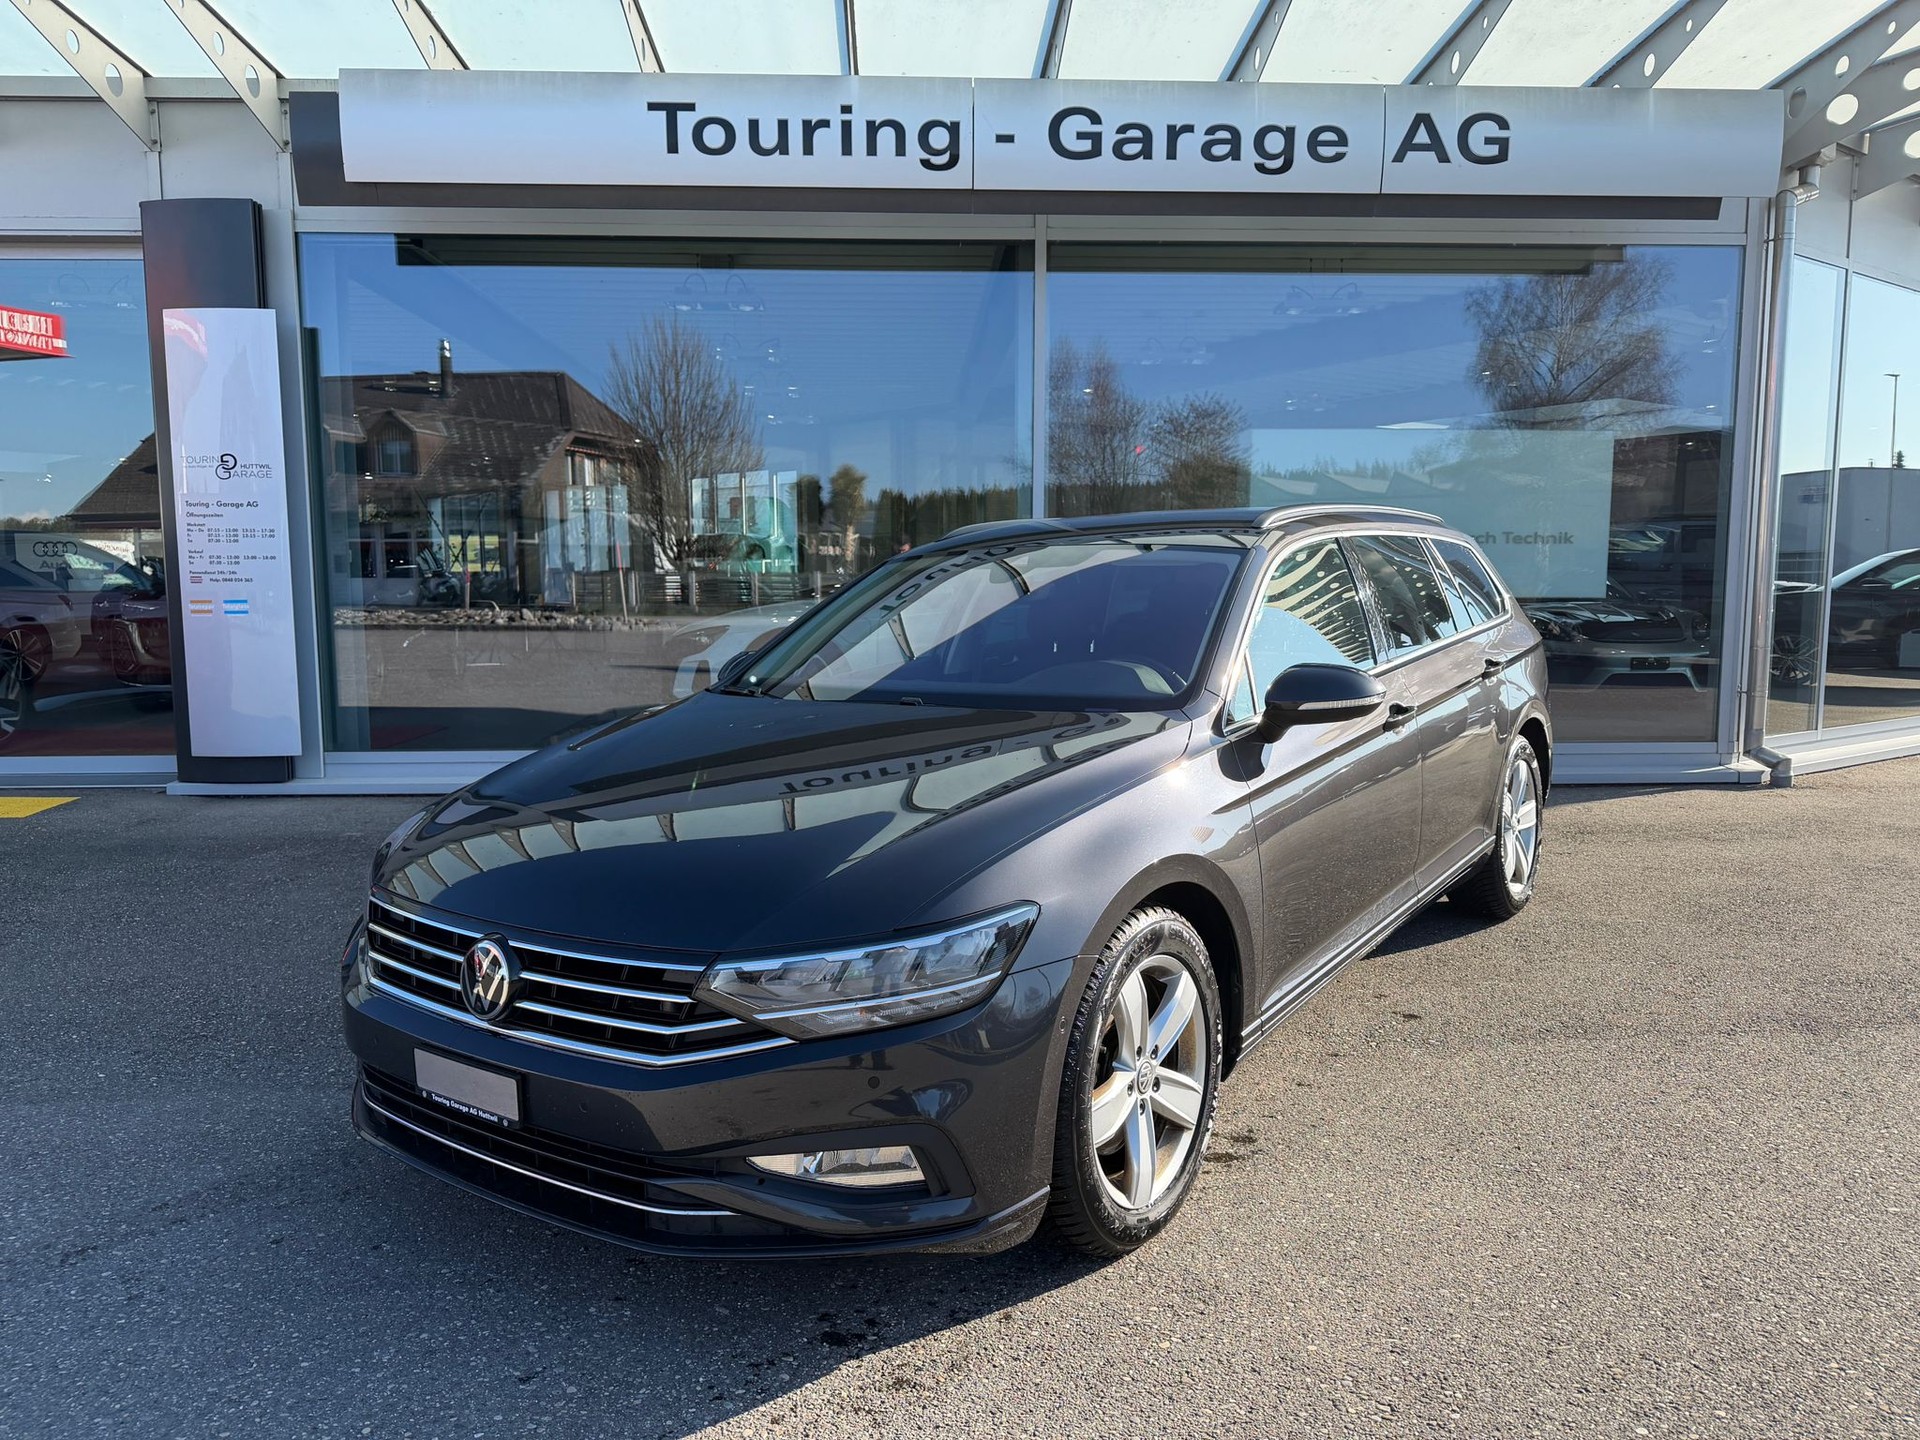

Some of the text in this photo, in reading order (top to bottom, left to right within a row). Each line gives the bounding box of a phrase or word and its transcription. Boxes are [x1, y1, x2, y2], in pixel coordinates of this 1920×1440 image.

[647, 102, 1511, 175] Touring - Garage AG
[185, 501, 210, 509] Touring
[216, 501, 245, 509] Garage
[1472, 532, 1575, 545] ch Technik
[431, 1093, 450, 1107] Touring
[450, 1100, 469, 1112] Garage
[469, 1106, 478, 1115] AG
